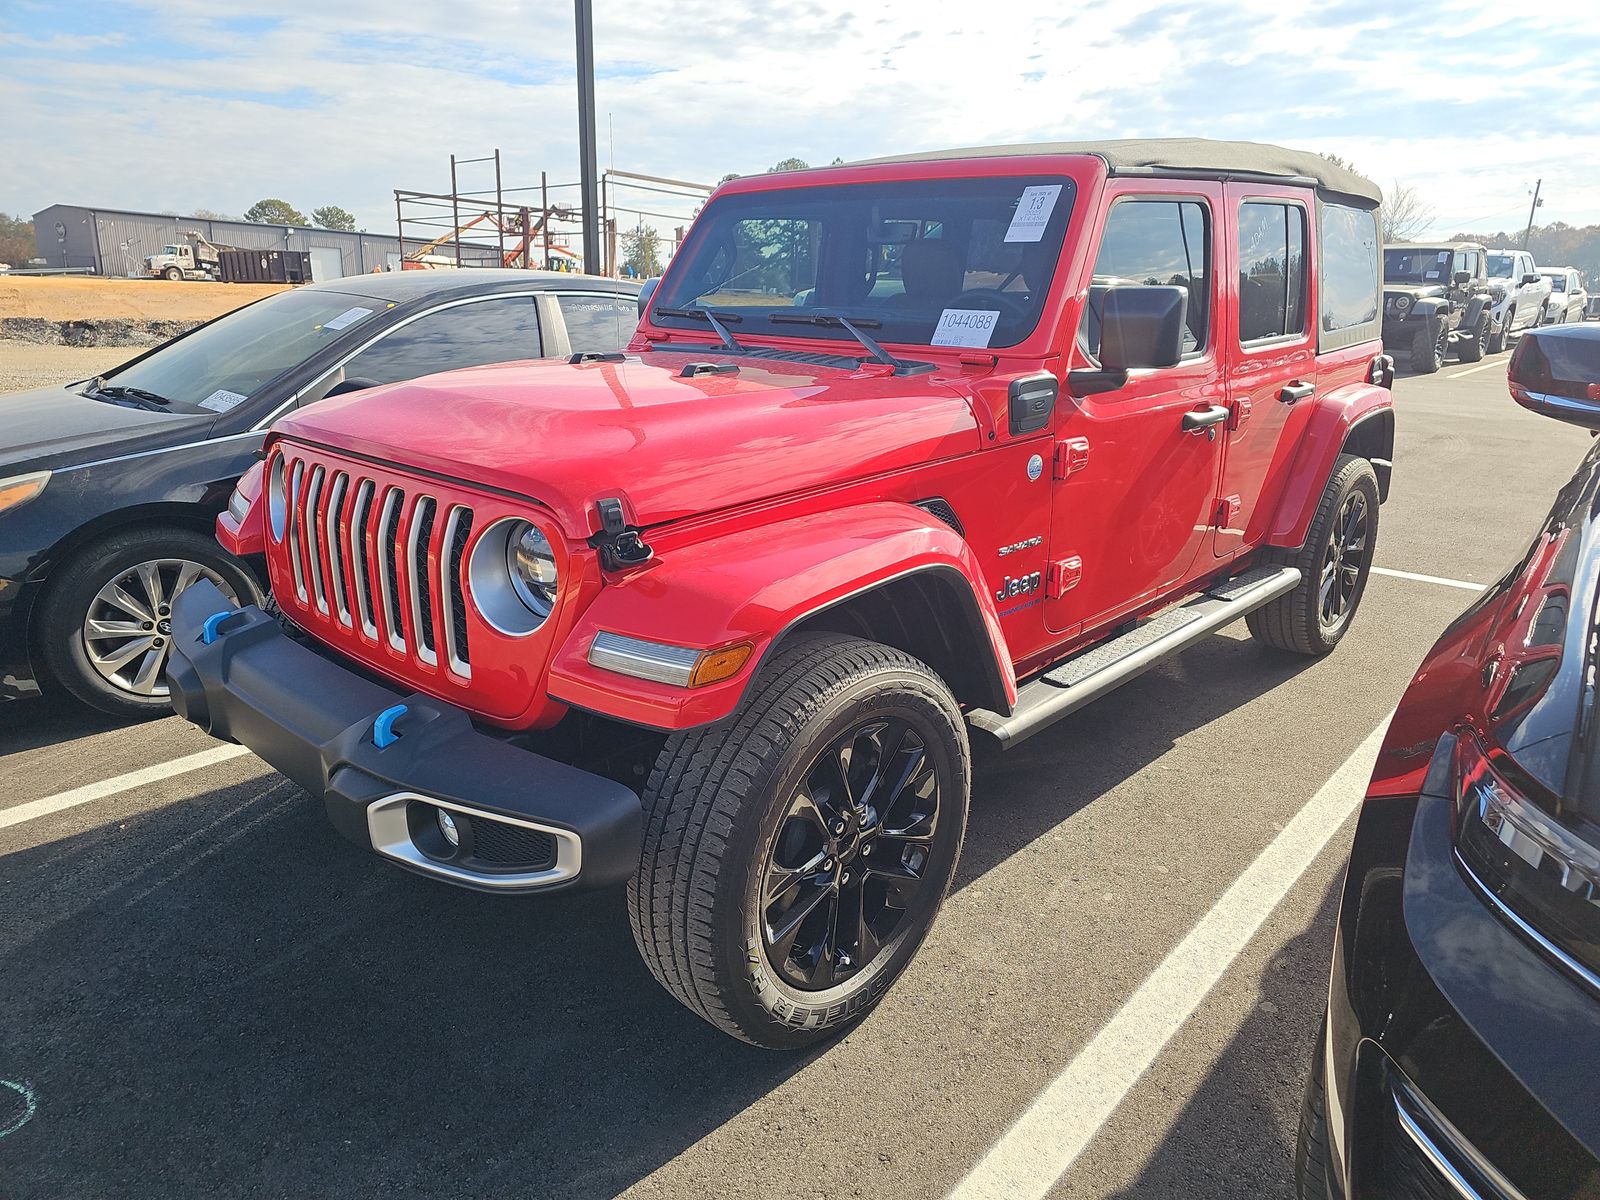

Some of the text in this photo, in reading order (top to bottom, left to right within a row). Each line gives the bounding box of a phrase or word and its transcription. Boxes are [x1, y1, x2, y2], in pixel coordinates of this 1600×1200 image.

[942, 313, 993, 330] 1044088
[998, 536, 1043, 556] SAHARA
[996, 571, 1041, 602] Jeep
[771, 968, 890, 1027] DUELER
